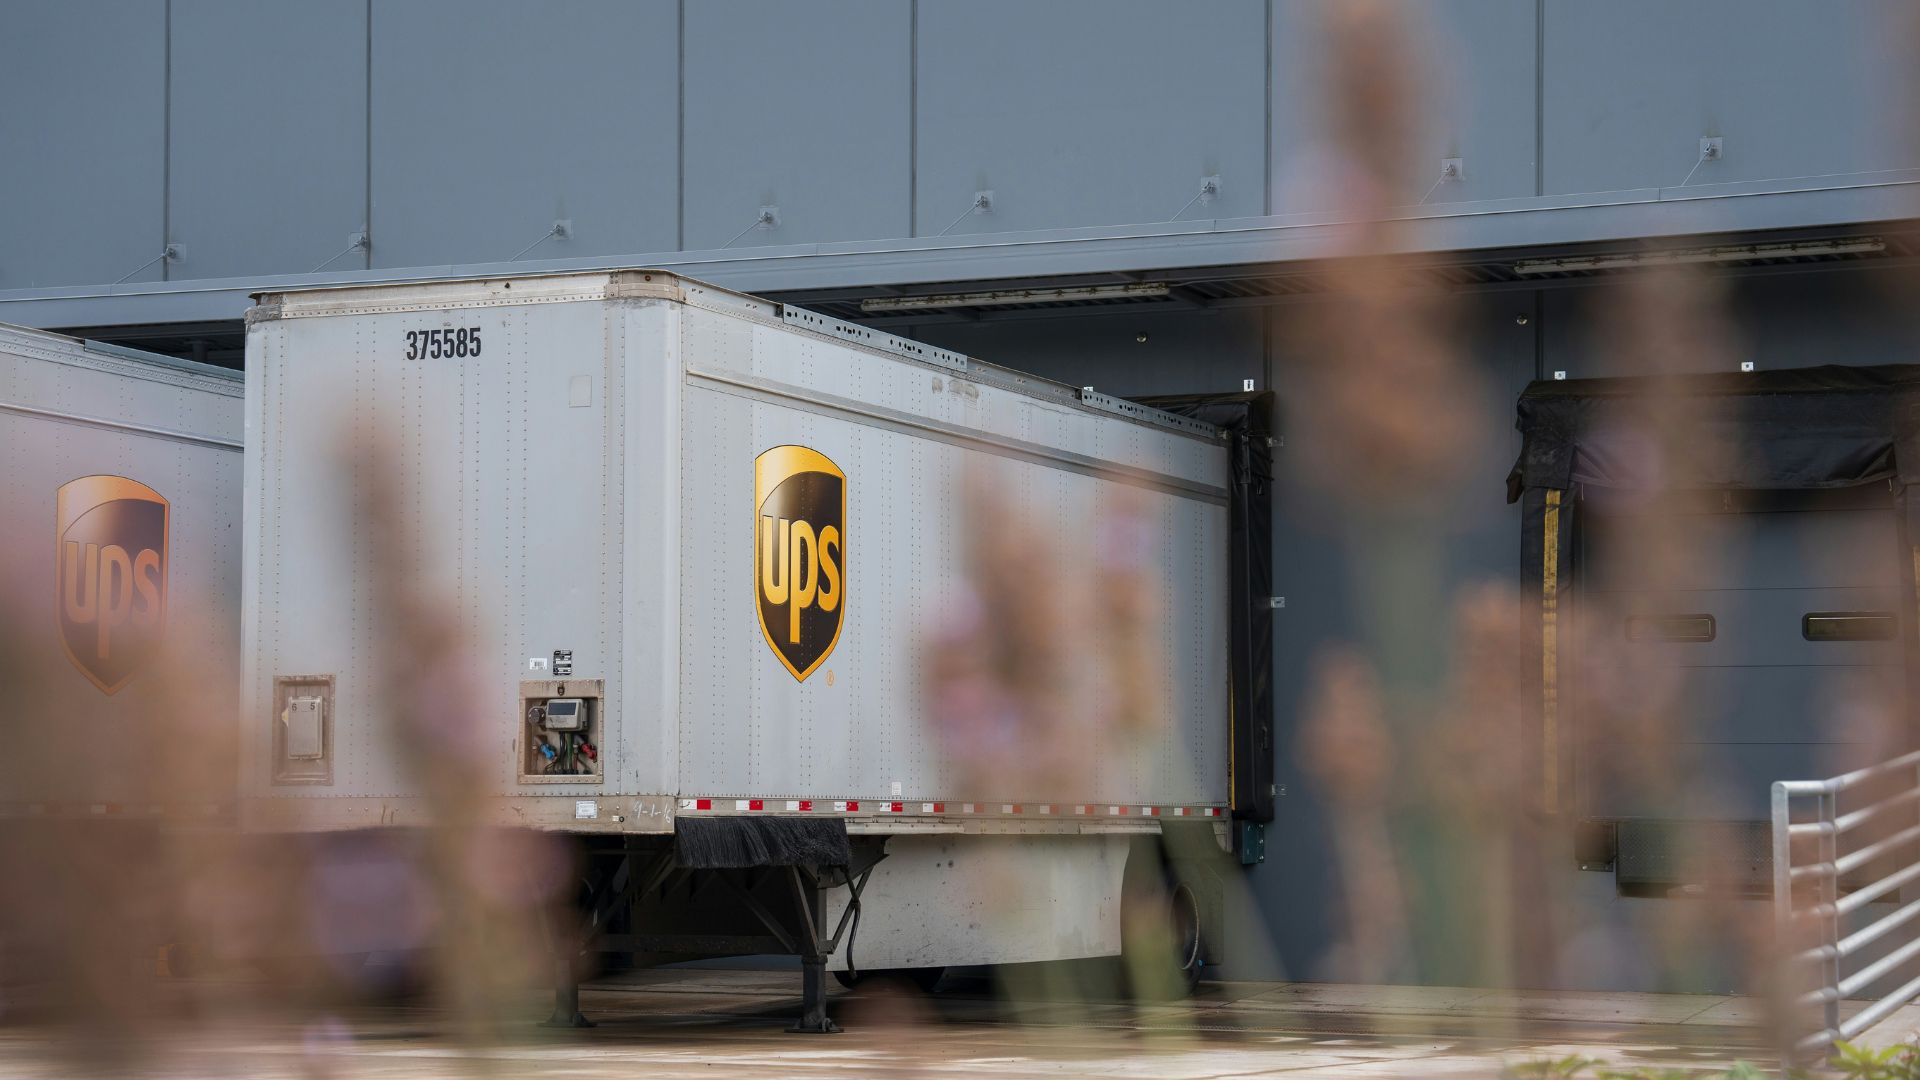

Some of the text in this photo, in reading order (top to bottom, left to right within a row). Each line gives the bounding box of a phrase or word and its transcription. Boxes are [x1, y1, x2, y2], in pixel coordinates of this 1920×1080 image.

[406, 327, 481, 361] 375585
[65, 541, 160, 659] ups
[762, 515, 840, 644] ups
[310, 702, 316, 711] 5
